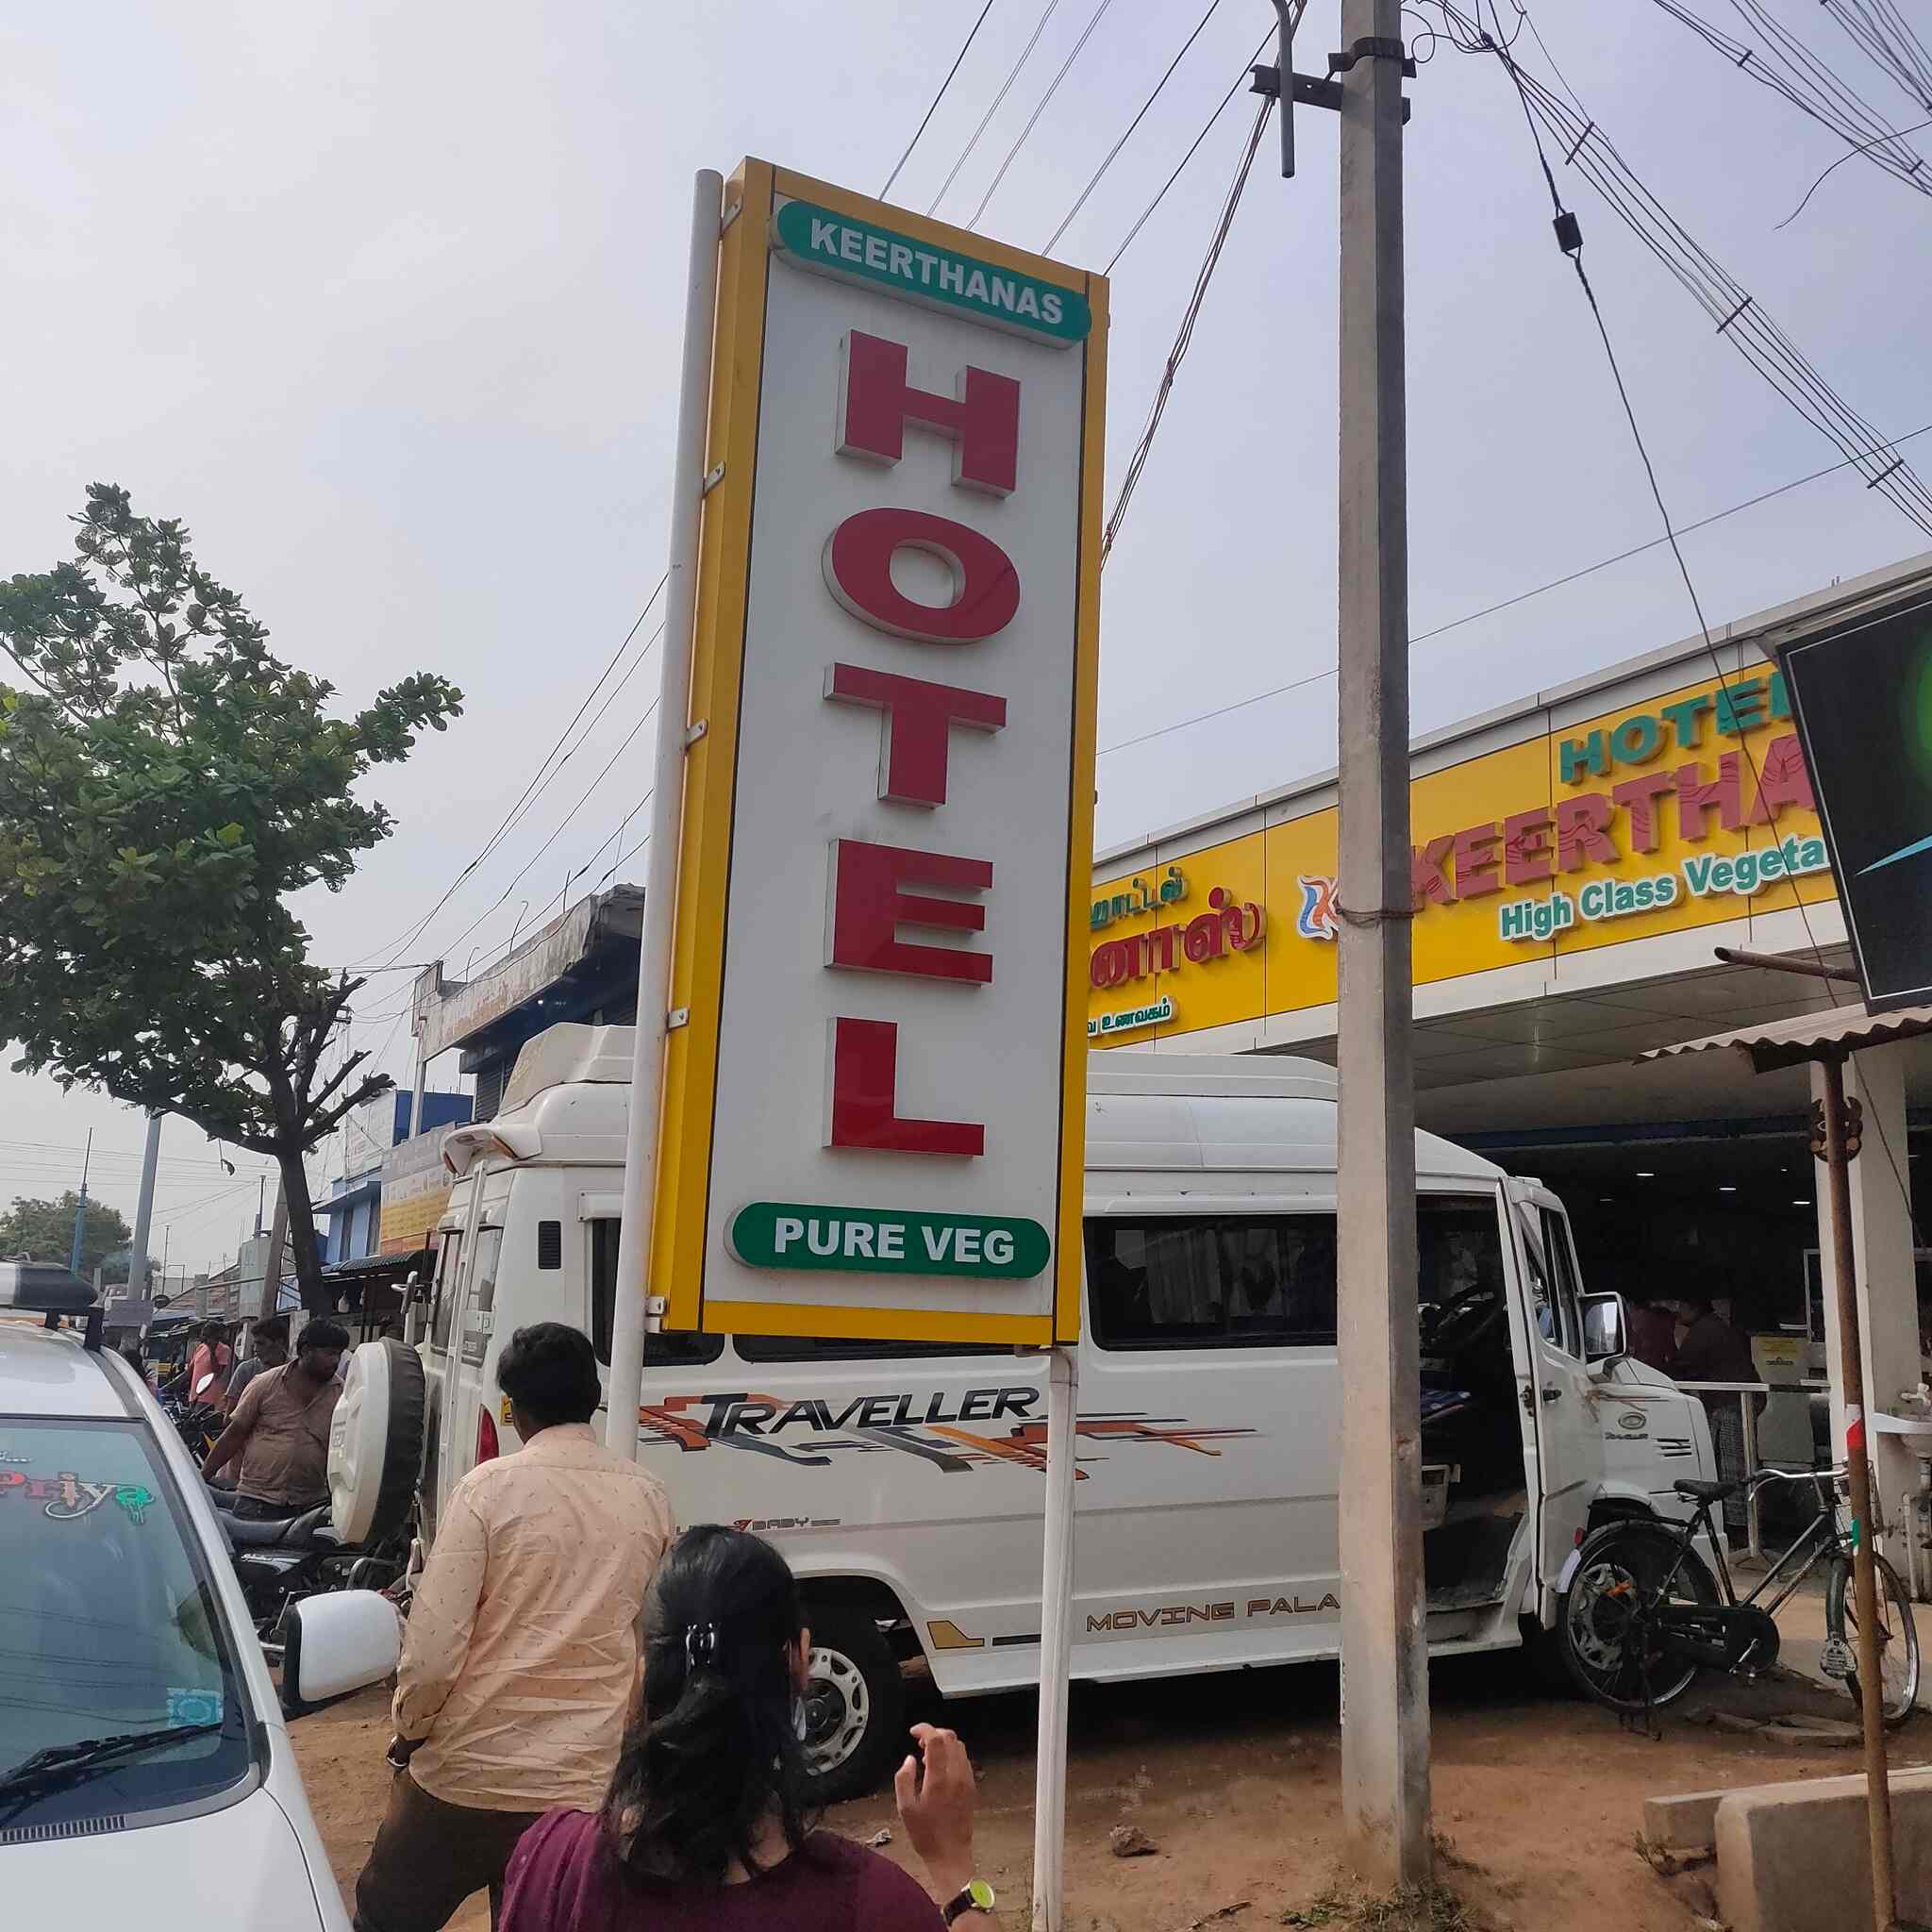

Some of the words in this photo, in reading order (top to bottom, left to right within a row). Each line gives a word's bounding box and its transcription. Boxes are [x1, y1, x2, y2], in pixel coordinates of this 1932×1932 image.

[809, 218, 1064, 325] KEERTHANAS
[830, 329, 1021, 1157] HOTEL
[1501, 894, 1573, 938] High
[1580, 875, 1675, 917] Class
[1684, 836, 1826, 892] Vegeta
[1091, 886, 1261, 988] னாஸ்
[1101, 996, 1172, 1031] உணவகம்
[774, 1217, 906, 1261] PURE
[920, 1224, 1016, 1265] VEG
[701, 1387, 1040, 1439] TRAVELLER
[1086, 1602, 1236, 1632] MOVING
[1246, 1592, 1341, 1617] PALA
